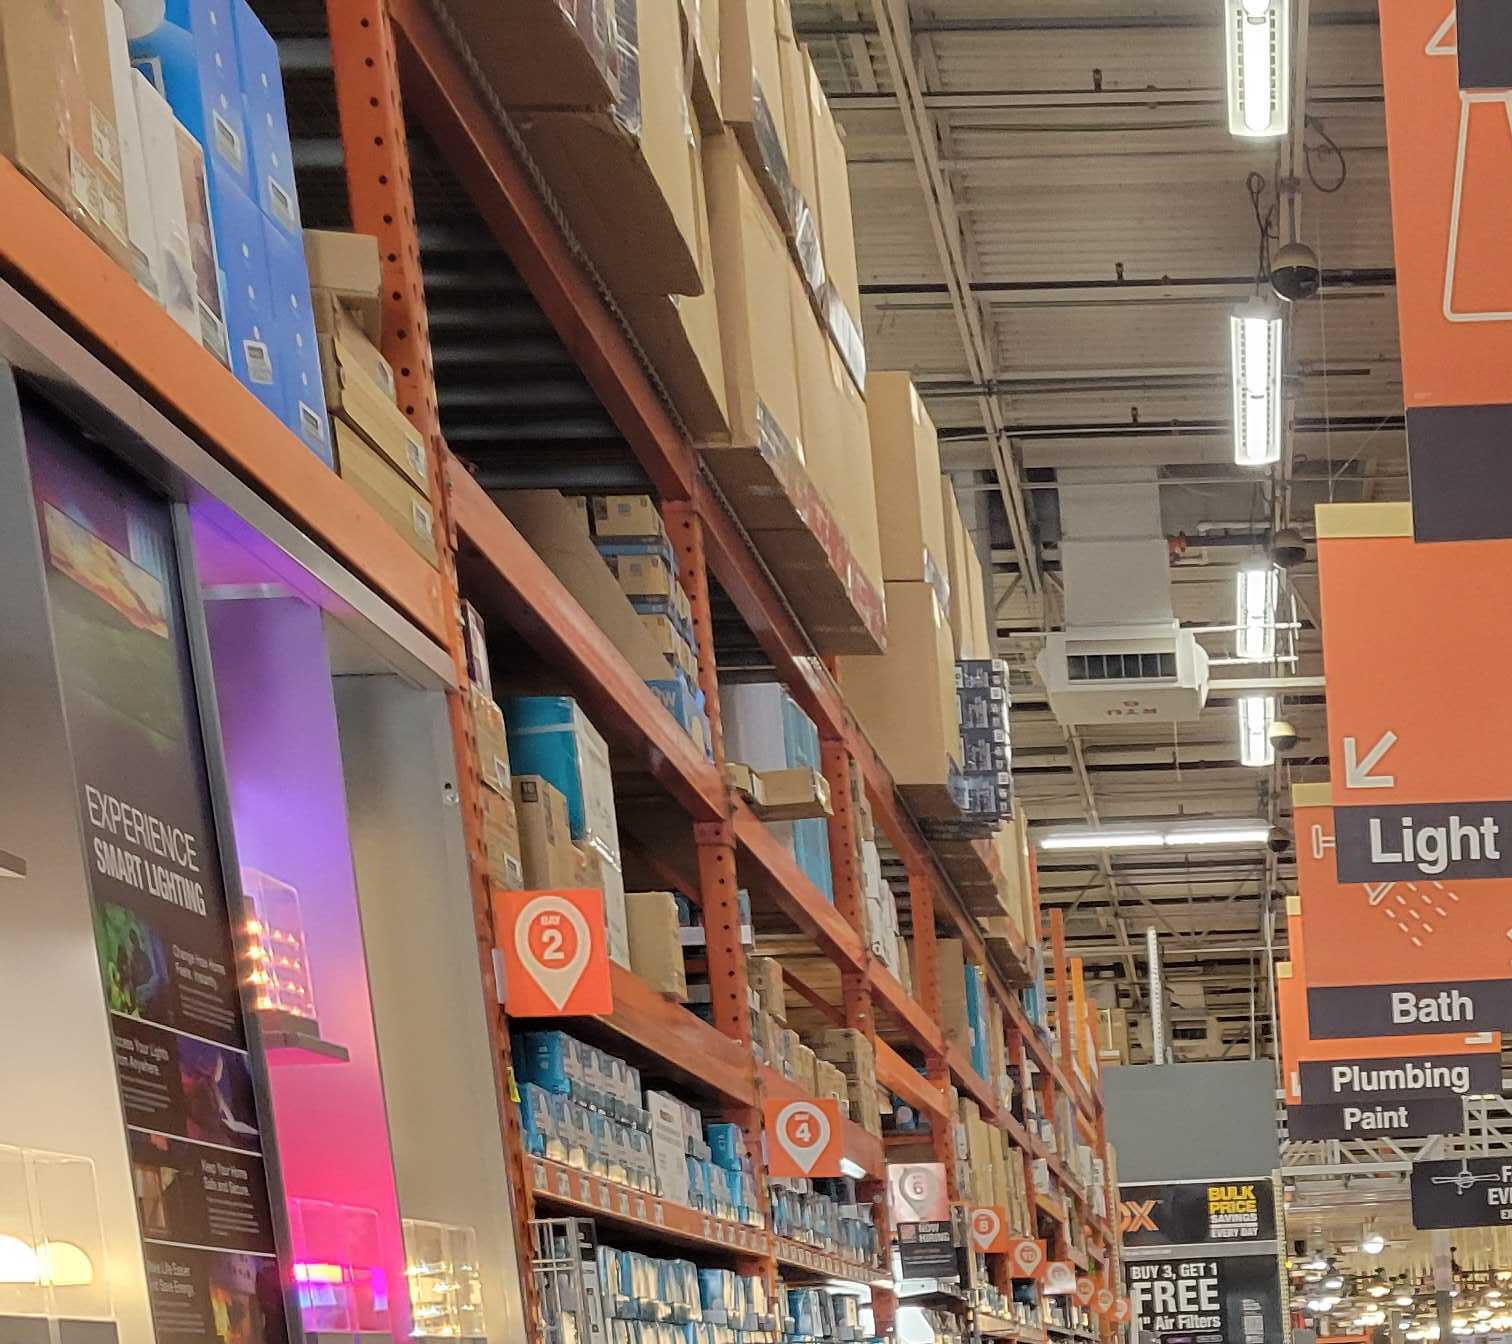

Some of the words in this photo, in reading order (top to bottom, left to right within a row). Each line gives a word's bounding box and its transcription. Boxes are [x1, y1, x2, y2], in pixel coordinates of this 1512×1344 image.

[85, 784, 200, 872] EXPERIENCE
[1369, 816, 1501, 873] Light
[94, 837, 143, 890] SMART
[144, 859, 206, 916] LIGHTING
[541, 929, 565, 961] 2
[1391, 989, 1474, 1023] Bath
[1332, 1062, 1471, 1096] Plumbing
[1343, 1107, 1409, 1131] Paint
[1207, 1185, 1256, 1200] BULK
[1208, 1200, 1257, 1214] PRICE
[1210, 1213, 1258, 1224] SAVINGS
[1130, 1265, 1159, 1280] BUY
[1162, 1264, 1177, 1280] 3,
[1178, 1262, 1206, 1278] GET
[1210, 1262, 1218, 1276] 1
[1130, 1278, 1221, 1315] FREE
[1155, 1315, 1175, 1331] Air
[1178, 1314, 1222, 1330] Filters
